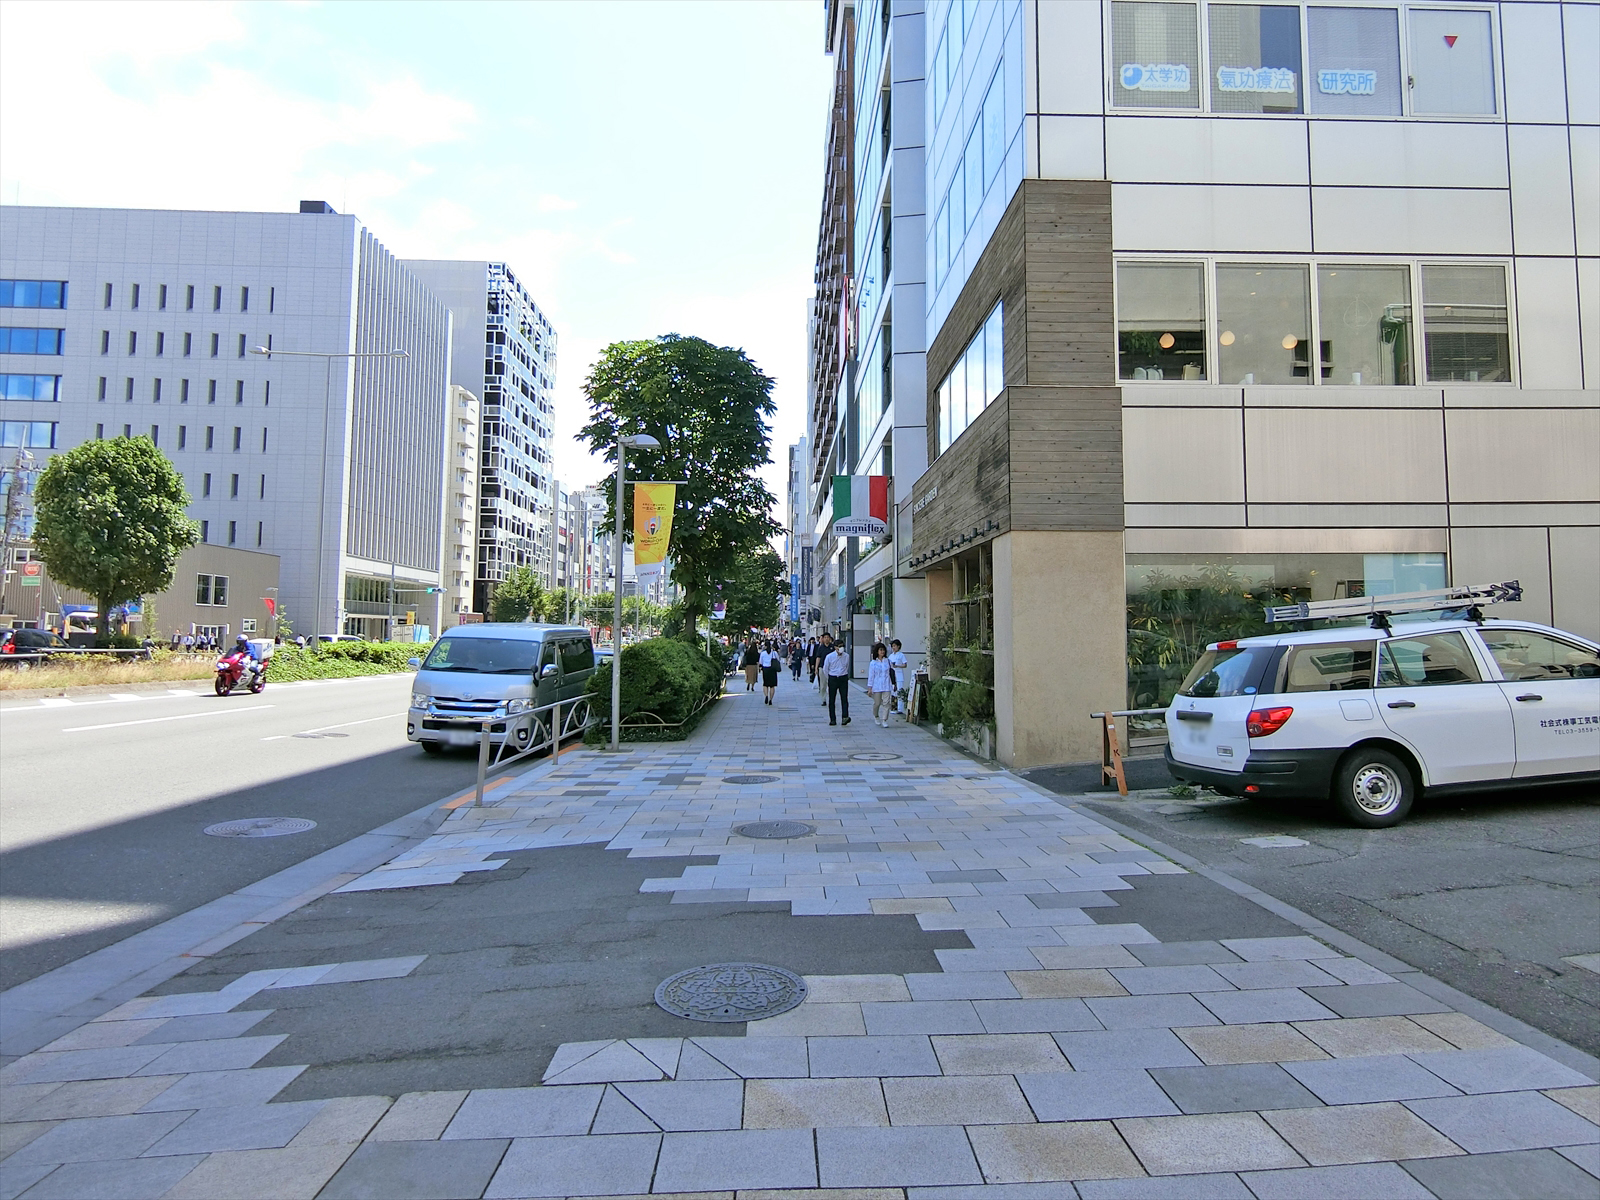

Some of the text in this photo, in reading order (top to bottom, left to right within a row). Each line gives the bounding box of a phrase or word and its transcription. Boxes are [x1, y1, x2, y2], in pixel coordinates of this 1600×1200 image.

[1144, 67, 1188, 83] 太学功
[1220, 69, 1292, 90] 氣功療法
[1321, 71, 1375, 92] 研究所
[835, 523, 885, 535] magniflex
